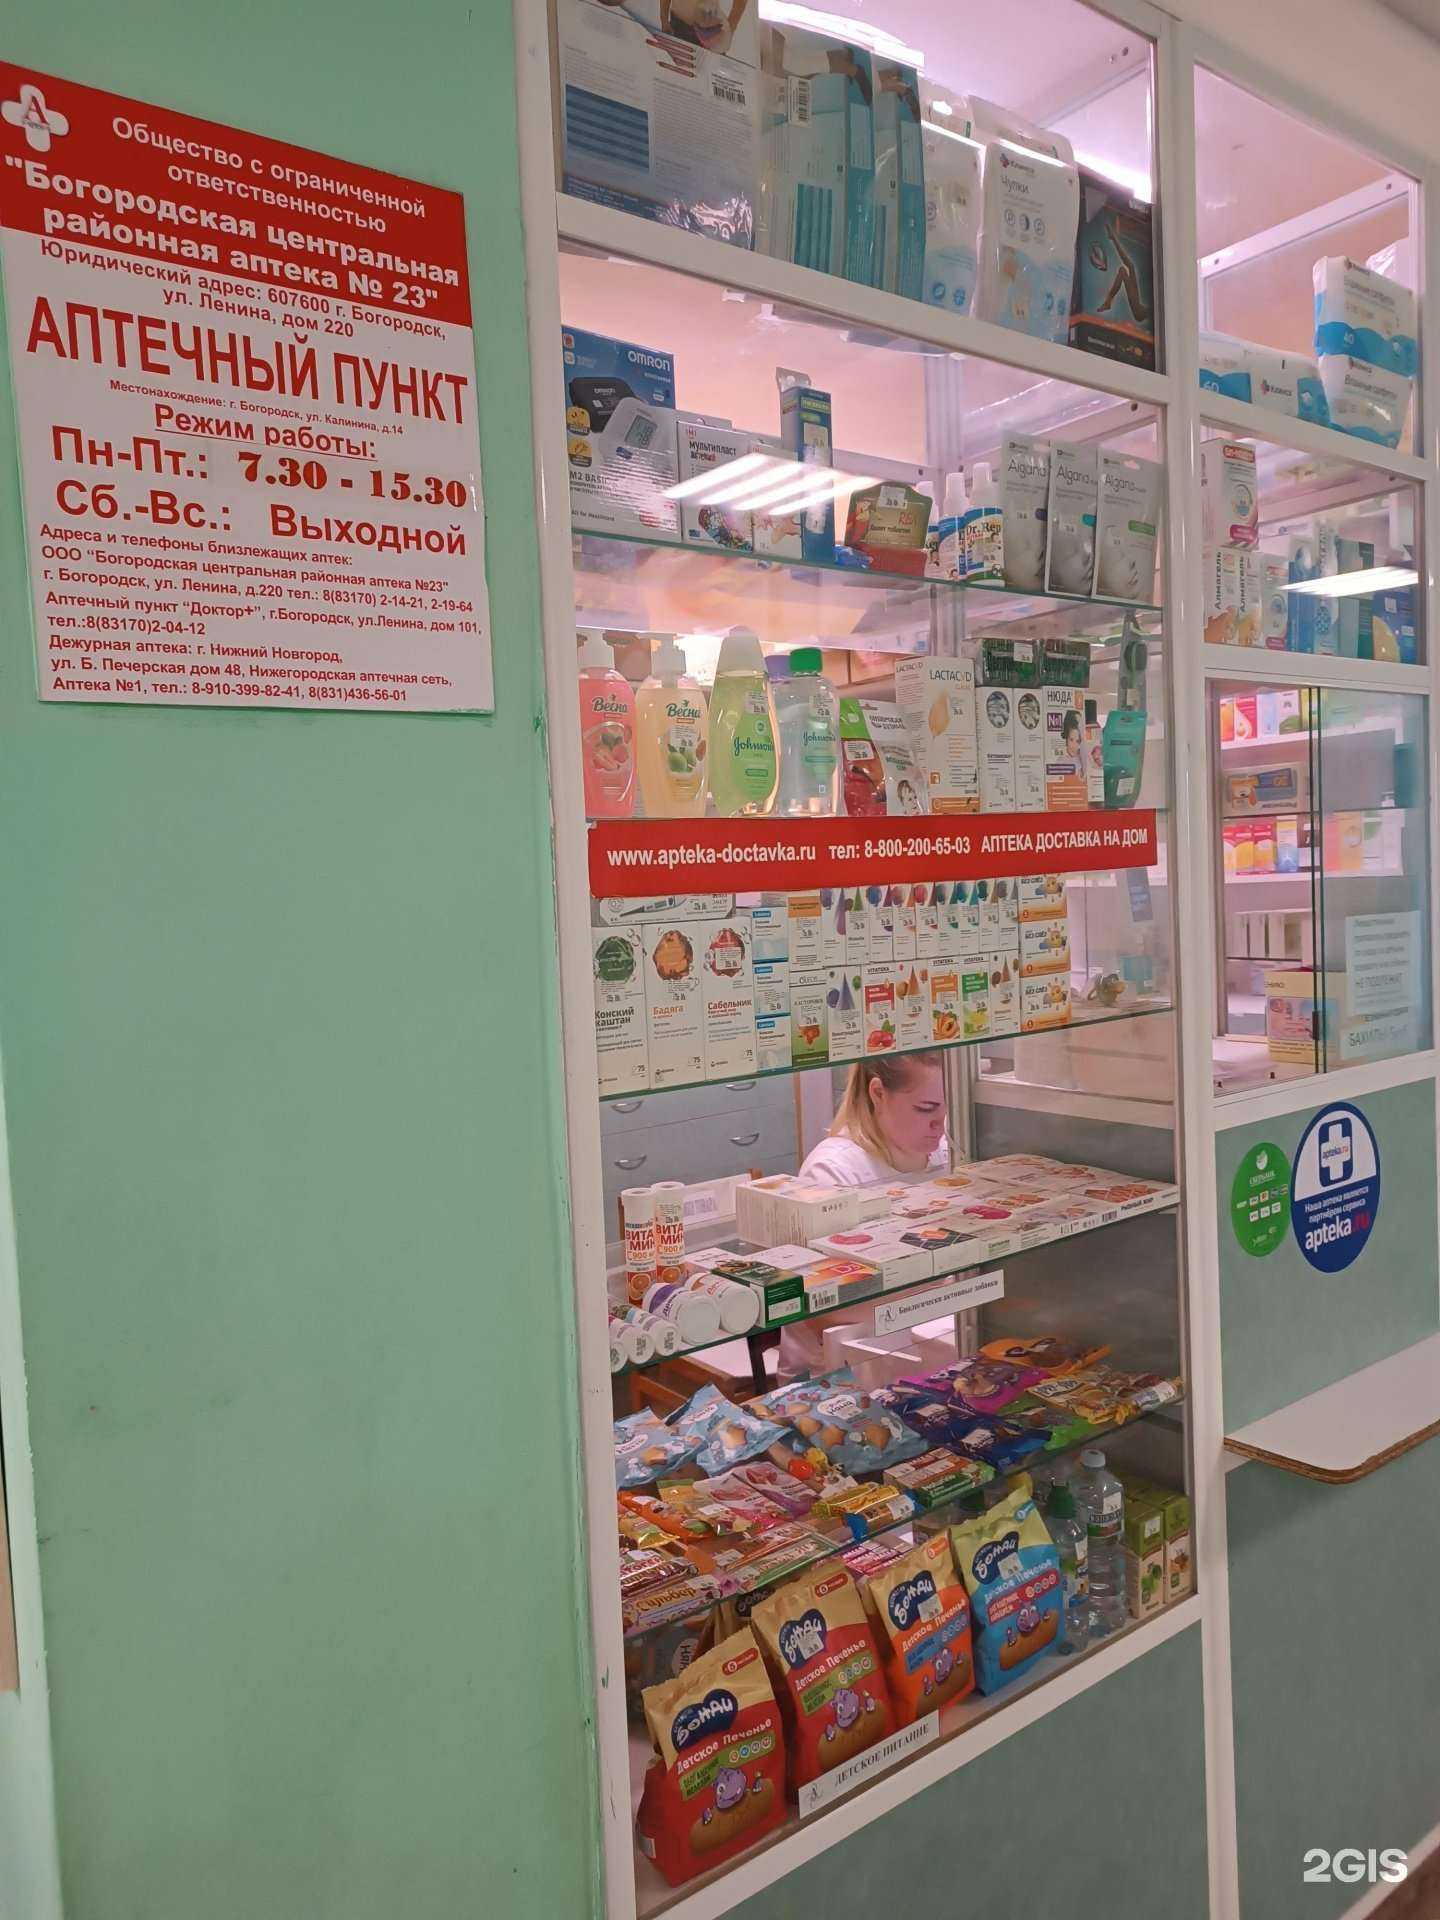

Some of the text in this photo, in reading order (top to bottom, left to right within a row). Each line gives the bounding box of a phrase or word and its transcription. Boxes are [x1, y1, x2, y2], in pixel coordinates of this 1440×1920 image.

[112, 116, 425, 218] Общество с ограниченной
[168, 164, 386, 233] ответственностью
[5, 155, 458, 287] "Богородская центральная
[44, 207, 438, 309] районная аптека № 23"
[41, 239, 446, 341] Юридический адрес: 607600 г. Богородск,
[163, 288, 354, 337] ул. Ленина, дом 220
[27, 296, 468, 424] АПТЕЧНЫЙ ПУНКТ
[628, 350, 671, 372] OMRON
[110, 380, 403, 434] Местонахождение: г. Богородск, ул. Калинина, д.14
[155, 403, 376, 459] Режим работы:
[52, 425, 466, 507] Пн-Пт.: 7.30 - 15.30
[57, 479, 466, 555] Сб.-Вс.: Выходной
[40, 524, 352, 566] Адреса и телефоны близлежащих аптек:
[41, 546, 82, 561] ООО
[202, 559, 297, 582] центральная
[302, 571, 366, 588] районная
[370, 576, 411, 590] аптека
[44, 568, 473, 613] г. Богородск, ул. Ленина, д.220 тел.: 8(83170) 2-14-21, 2-19-64
[46, 591, 129, 612] Аптечный
[135, 597, 178, 615] пункт
[270, 608, 354, 628] г.Богородск,
[358, 614, 427, 632] ул.Ленина,
[431, 620, 454, 632] дом
[458, 620, 481, 636] 101,
[48, 615, 205, 636] тел.:8(83170)2-04-12
[50, 635, 343, 665] Дежурная аптека: г. Нижний Новгород,
[52, 657, 452, 687] ул. Б. Печерская дом 48, Нижегородская аптечная сеть,
[53, 677, 407, 702] Аптека №1, тел.: 8-910-399-82-41, 8(831)436-56-01
[930, 670, 972, 682] LACTACYD
[592, 696, 628, 713] Весна
[666, 702, 701, 718] Весна
[1047, 690, 1072, 704] НЮДА
[607, 827, 1149, 868] www.apteka-doctavka.ru тел: 8-800-200-65-03 АПТЕКА ДОСТАВКА НА ДОМ
[595, 1006, 634, 1018] Конский
[654, 1005, 684, 1016] Бадяга
[708, 1000, 752, 1010] Сабельник
[1305, 1202, 1322, 1213] Наша
[1322, 1195, 1343, 1208] аптека
[1342, 1198, 1366, 1212] сервиса
[626, 1230, 654, 1240] ВИТА
[656, 1223, 684, 1234] ВИТА
[1305, 1211, 1370, 1253] apteka.ru
[898, 1280, 998, 1314] Биологически активные добавки
[794, 1639, 866, 1690] Детское Печенье
[676, 1718, 772, 1775] Детское Печенье
[834, 1722, 929, 1787] ДЕТСКОЕ ПИТАНИЕ
